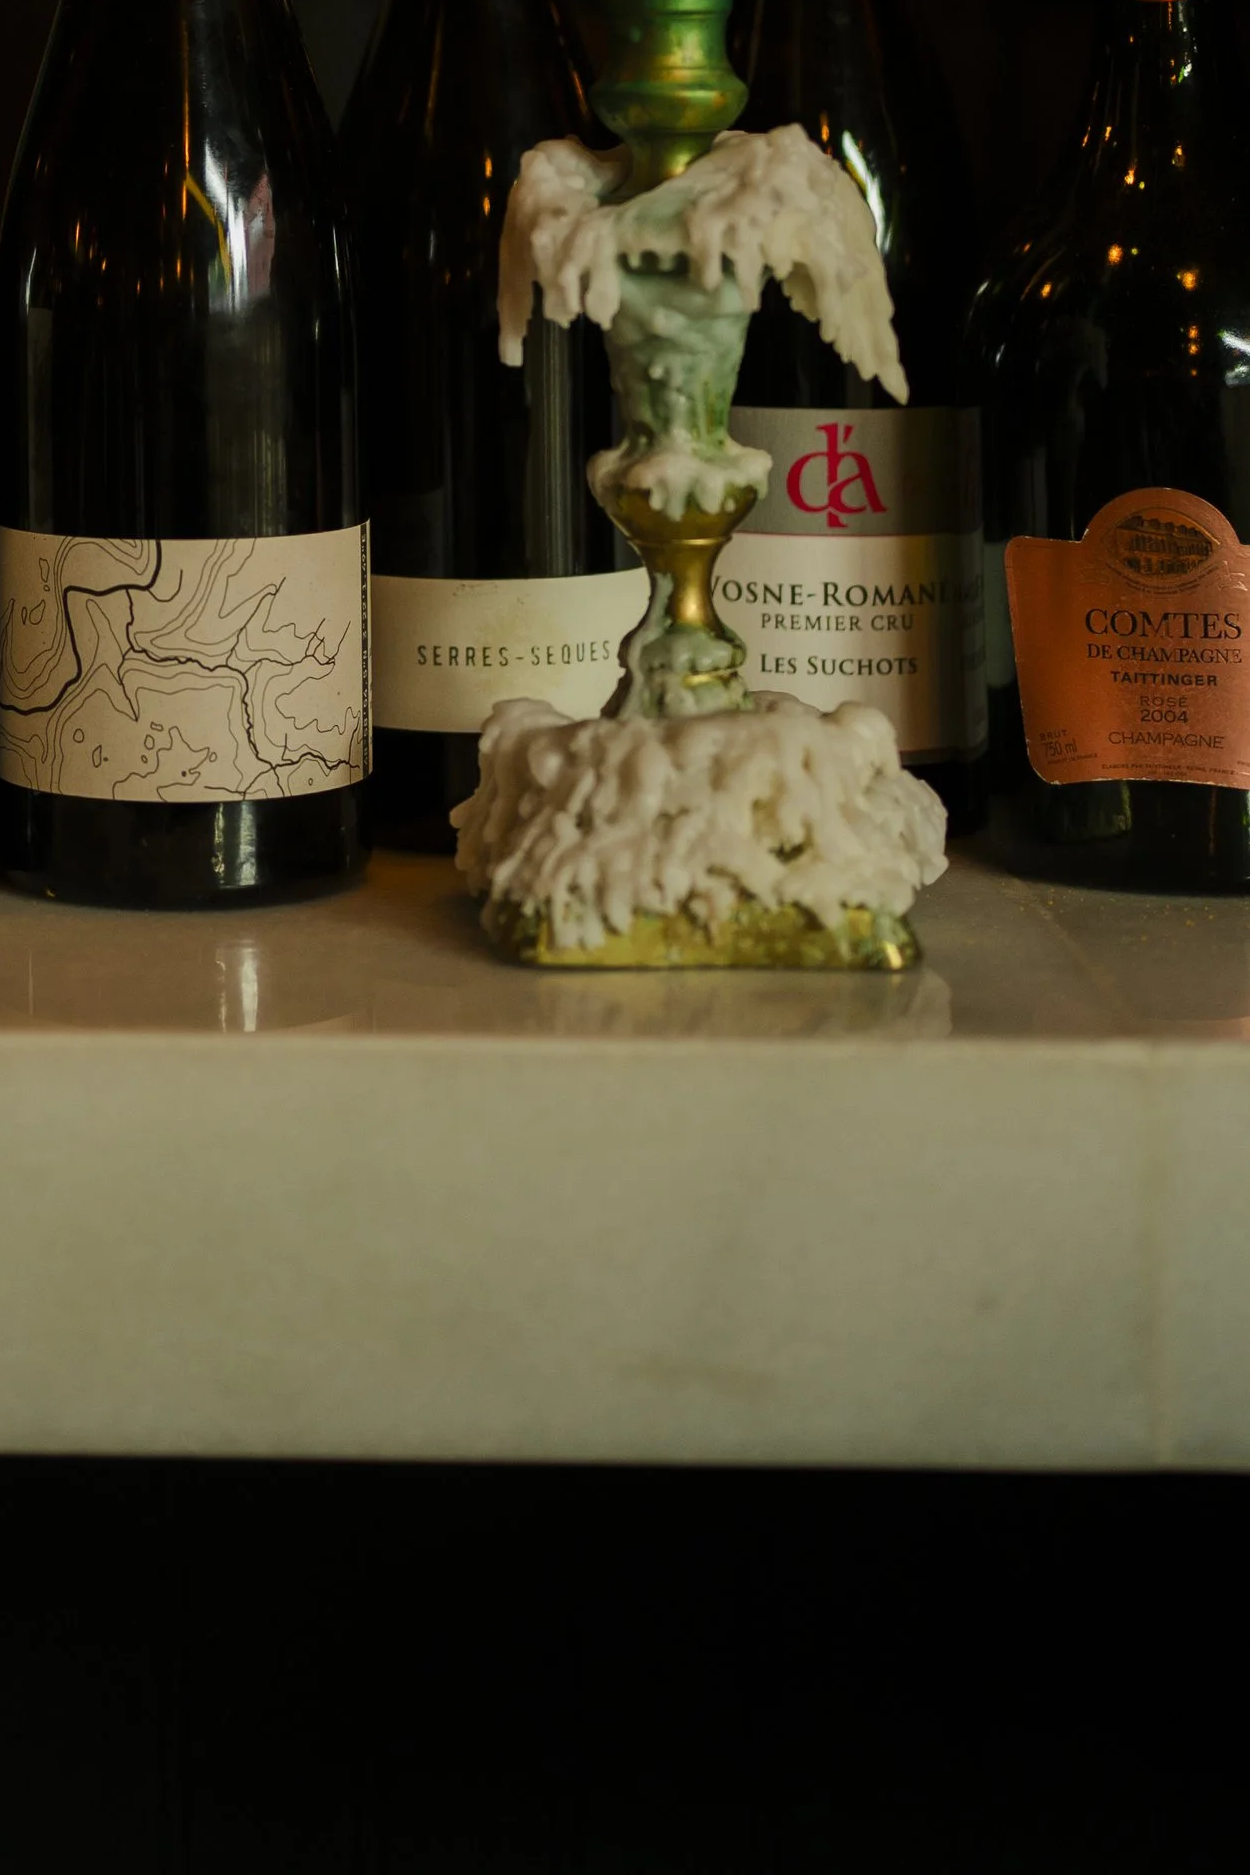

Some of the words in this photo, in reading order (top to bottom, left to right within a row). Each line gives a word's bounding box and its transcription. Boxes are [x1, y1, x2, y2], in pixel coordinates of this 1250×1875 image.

[761, 612, 863, 632] PREMIER
[871, 614, 914, 632] CRU
[1085, 608, 1242, 639] COMTES
[417, 639, 611, 668] SERRES-SEQUES
[1086, 643, 1112, 659] DE
[1116, 644, 1242, 664] CHAMPAGNE
[1110, 671, 1217, 687] TAITTINGER
[1140, 709, 1189, 724] 2004
[1042, 741, 1063, 758] 750
[1108, 731, 1226, 750] CHAMPAGNE
